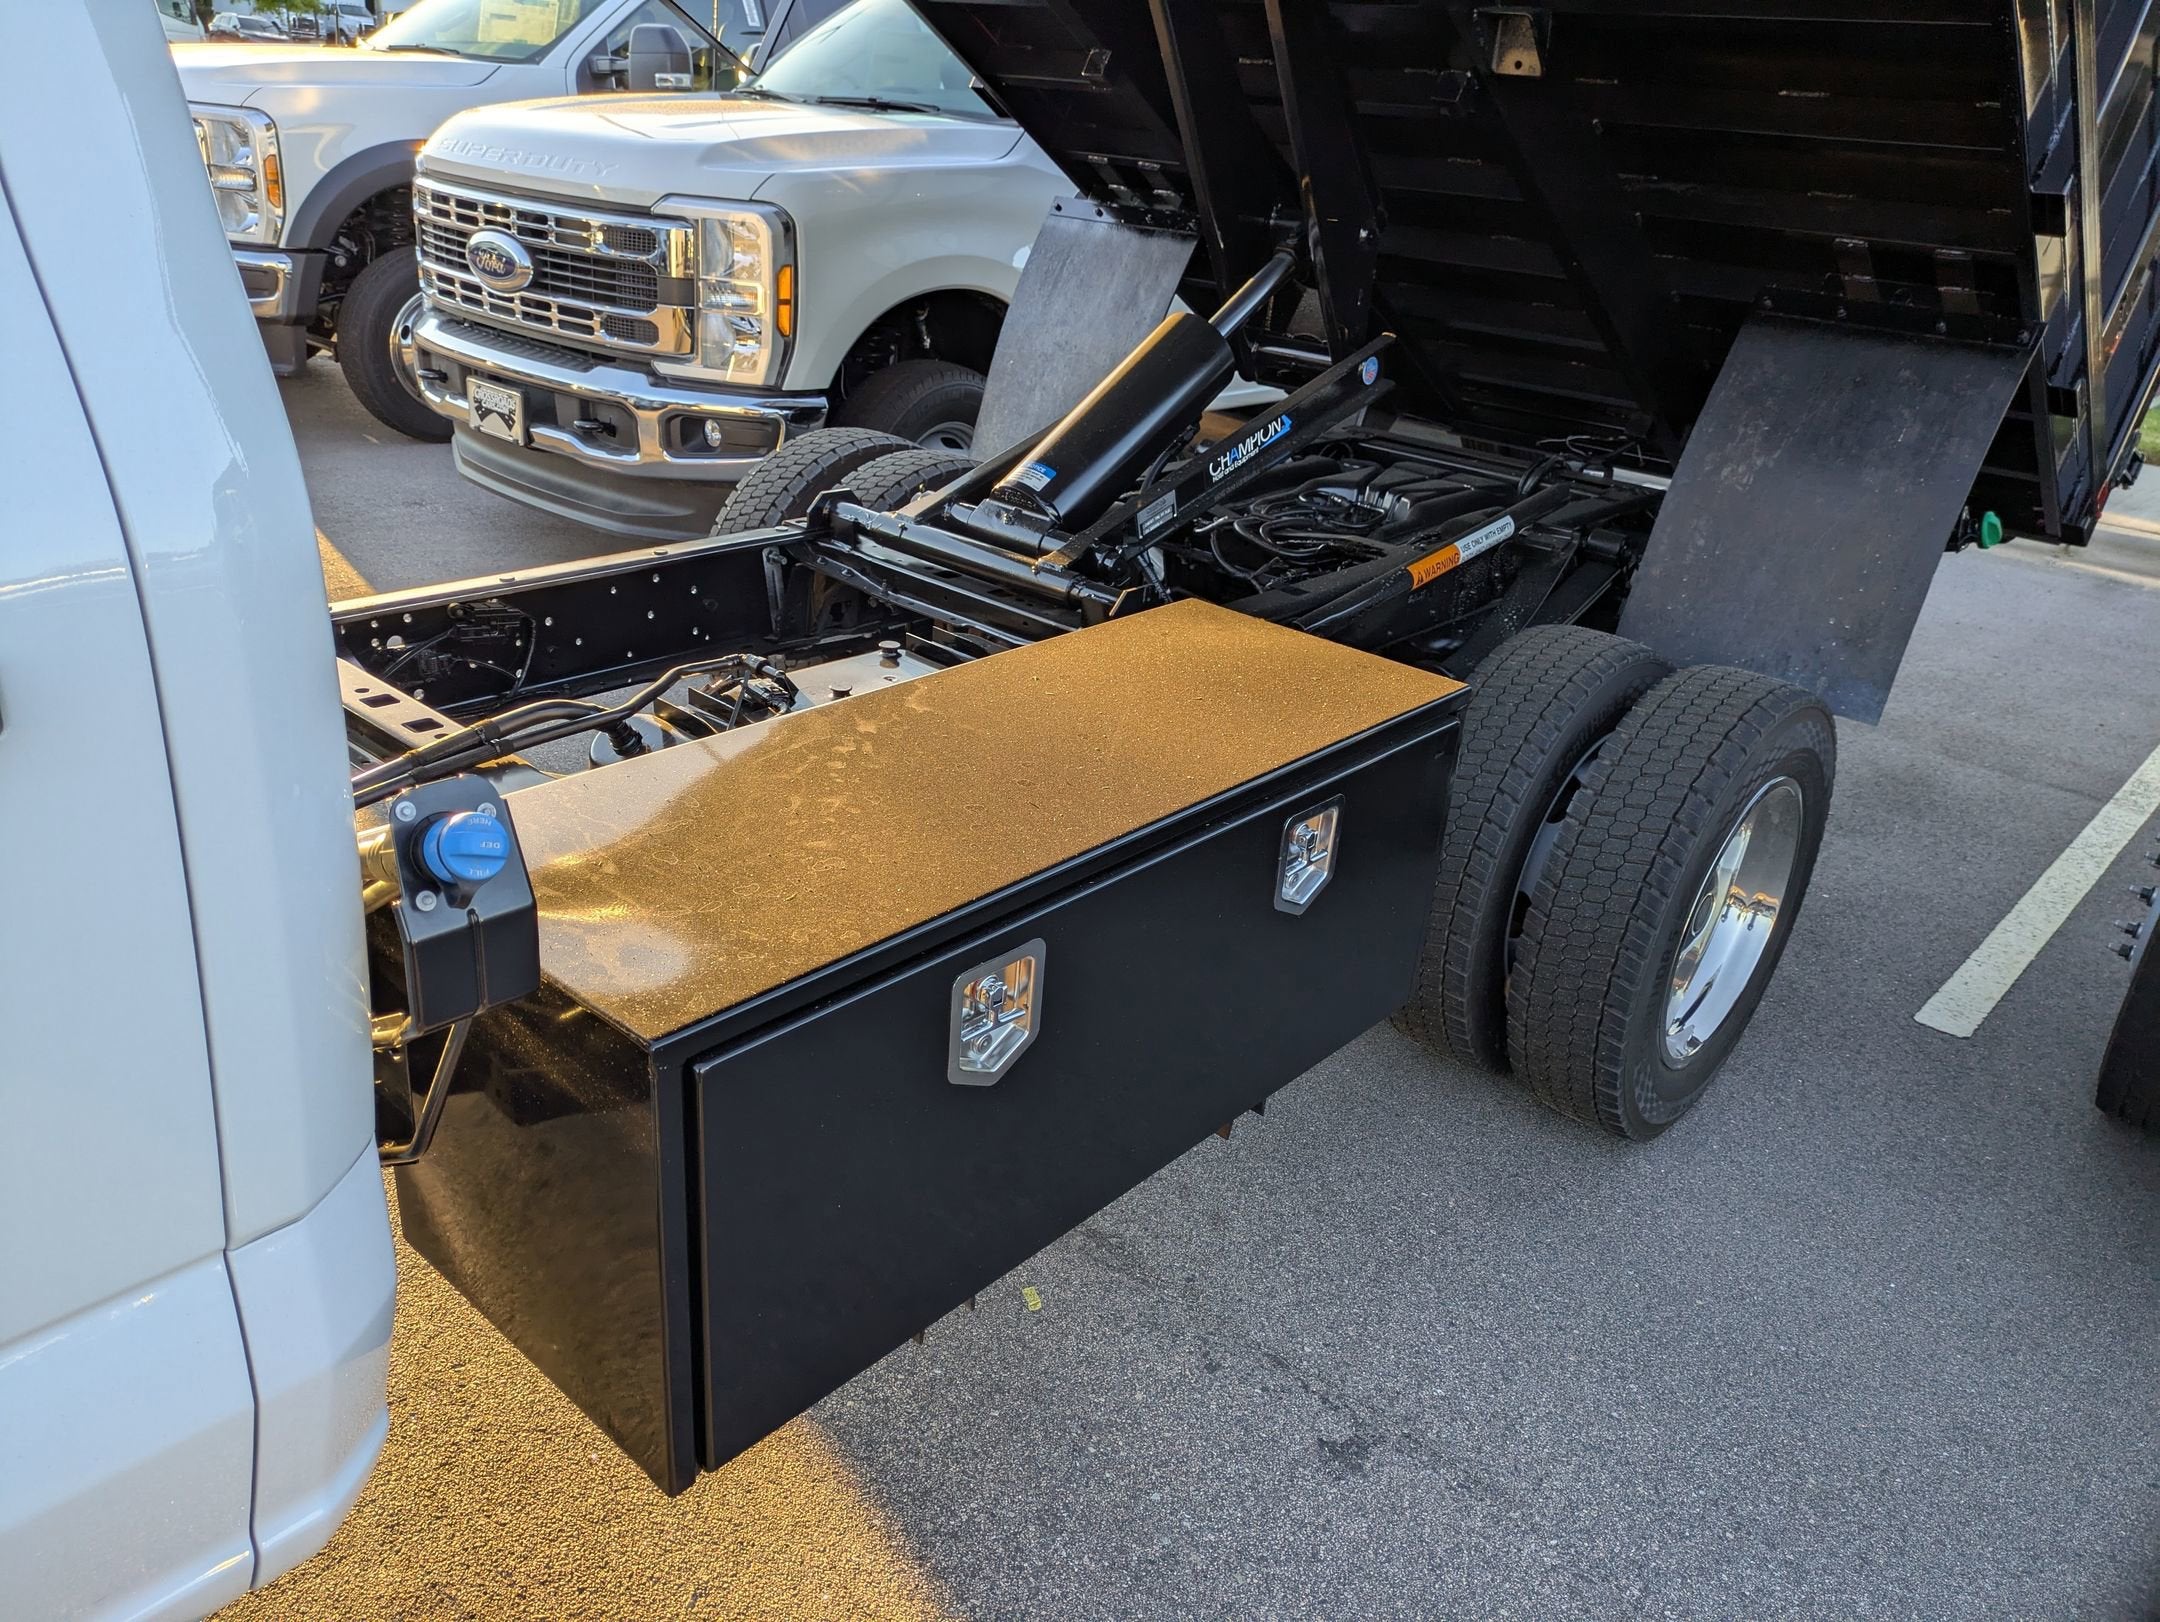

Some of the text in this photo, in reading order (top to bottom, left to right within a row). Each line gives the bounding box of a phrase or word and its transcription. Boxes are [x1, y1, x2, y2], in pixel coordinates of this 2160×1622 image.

[474, 247, 506, 275] Ford
[1209, 416, 1282, 477] CHAMPION
[1224, 464, 1235, 475] and
[1234, 447, 1259, 468] Equipment
[1460, 543, 1472, 554] USE
[1471, 536, 1485, 550] ONLY
[1484, 530, 1497, 543] WITH
[1496, 521, 1513, 537] EMPTY
[1423, 551, 1460, 578] WARNING
[480, 841, 500, 849] DEF
